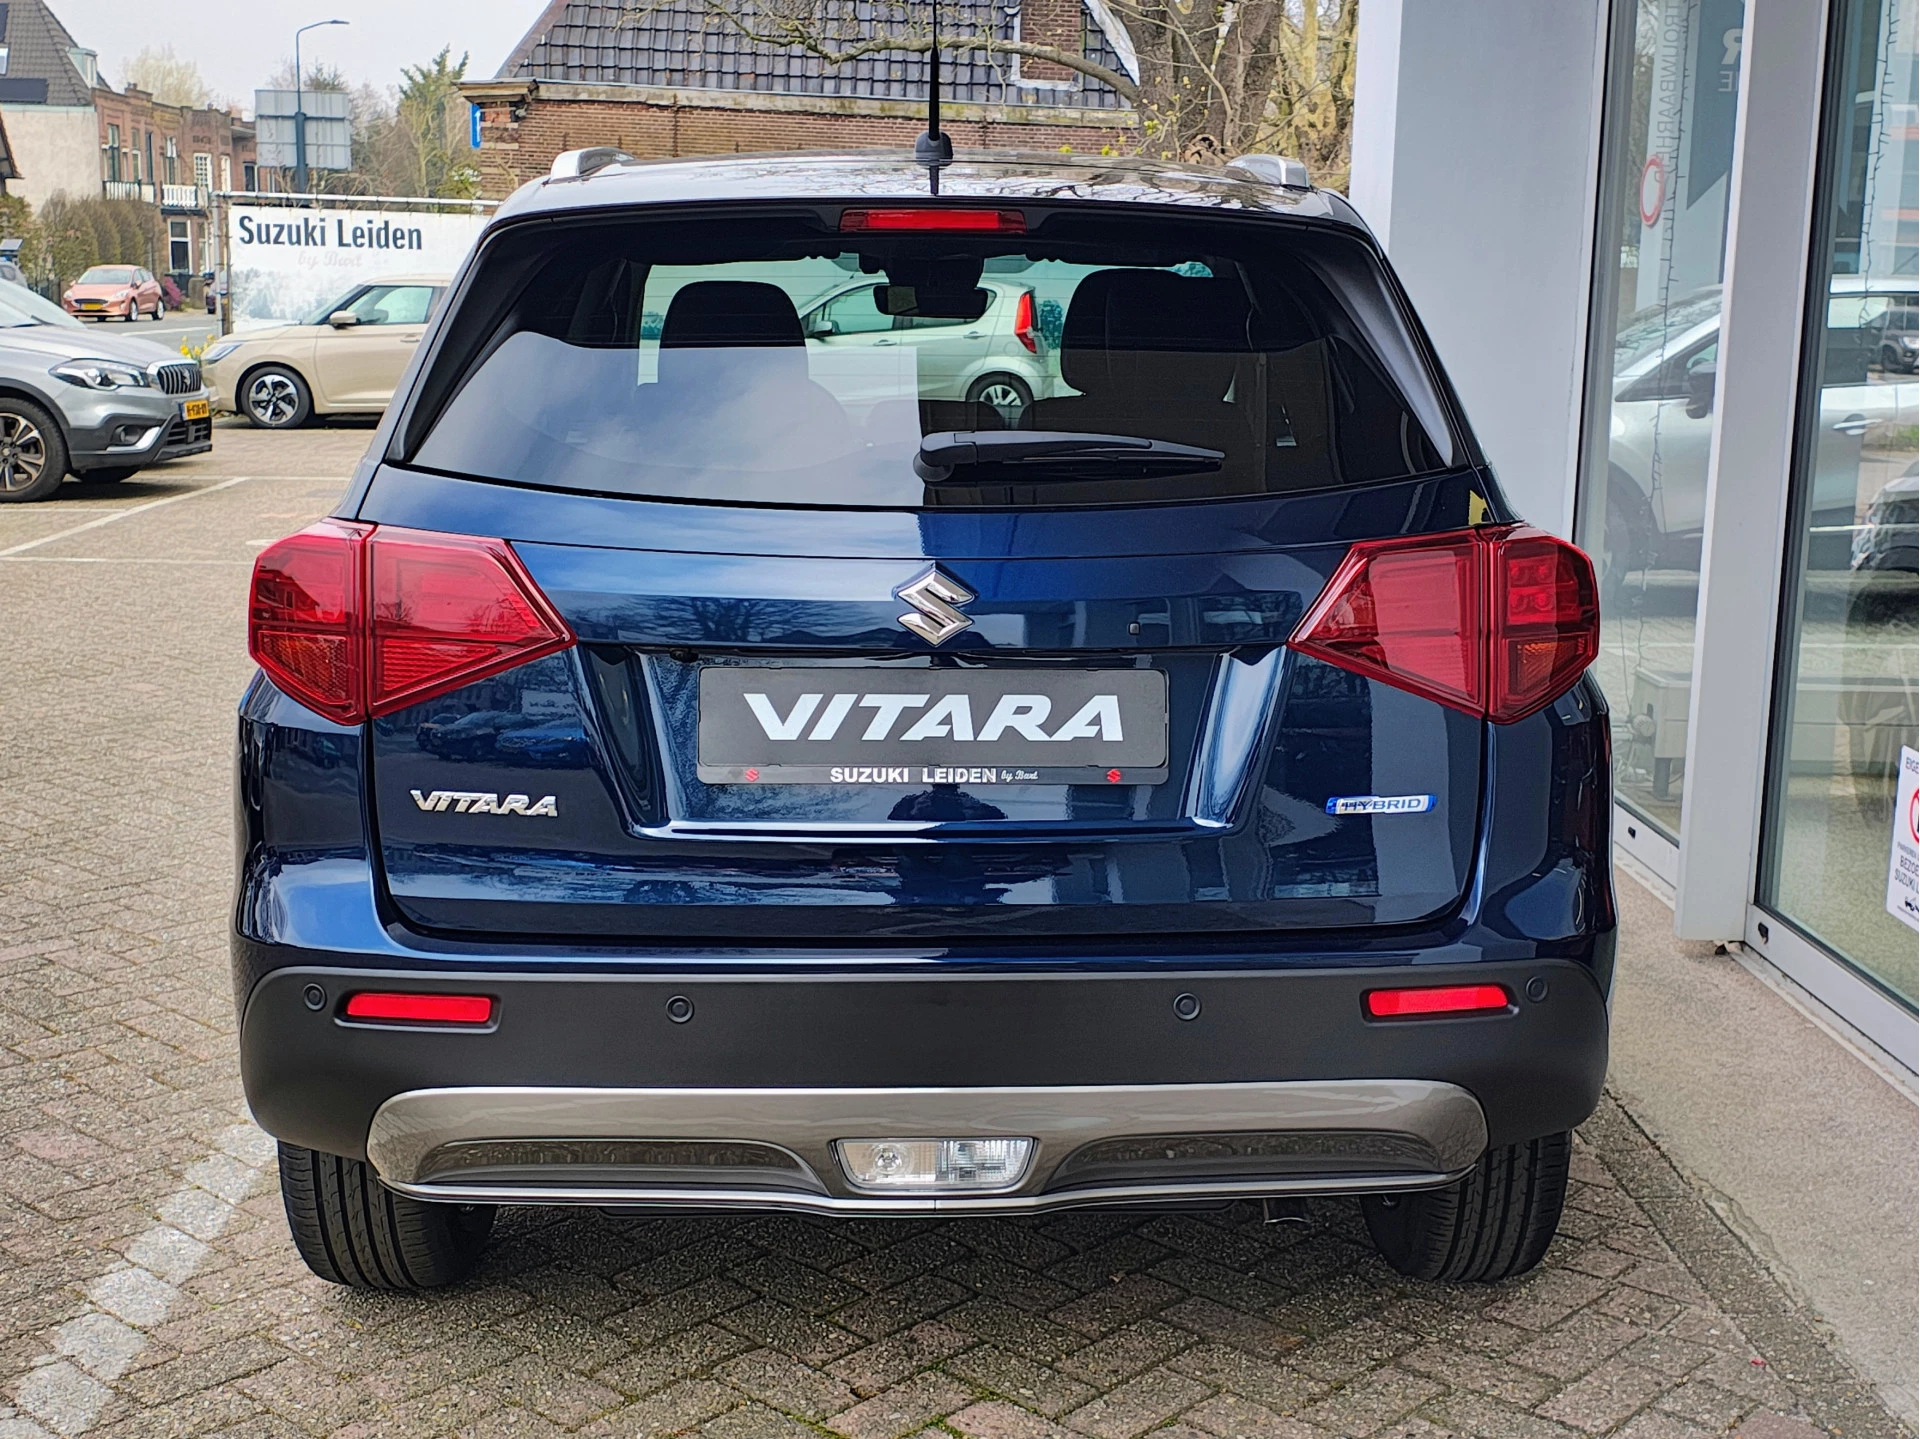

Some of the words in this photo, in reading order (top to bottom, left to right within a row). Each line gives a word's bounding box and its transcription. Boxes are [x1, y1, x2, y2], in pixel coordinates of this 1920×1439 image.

[239, 215, 326, 245] Suzuki
[337, 218, 422, 250] Leiden
[298, 251, 319, 270] by
[743, 693, 1124, 741] VITARA
[830, 767, 909, 783] SUZUKI
[922, 767, 996, 783] LEIDEN
[1000, 769, 1013, 783] by
[1014, 769, 1039, 780] Bart
[410, 789, 558, 817] VITARA
[1341, 798, 1422, 812] HYBRID
